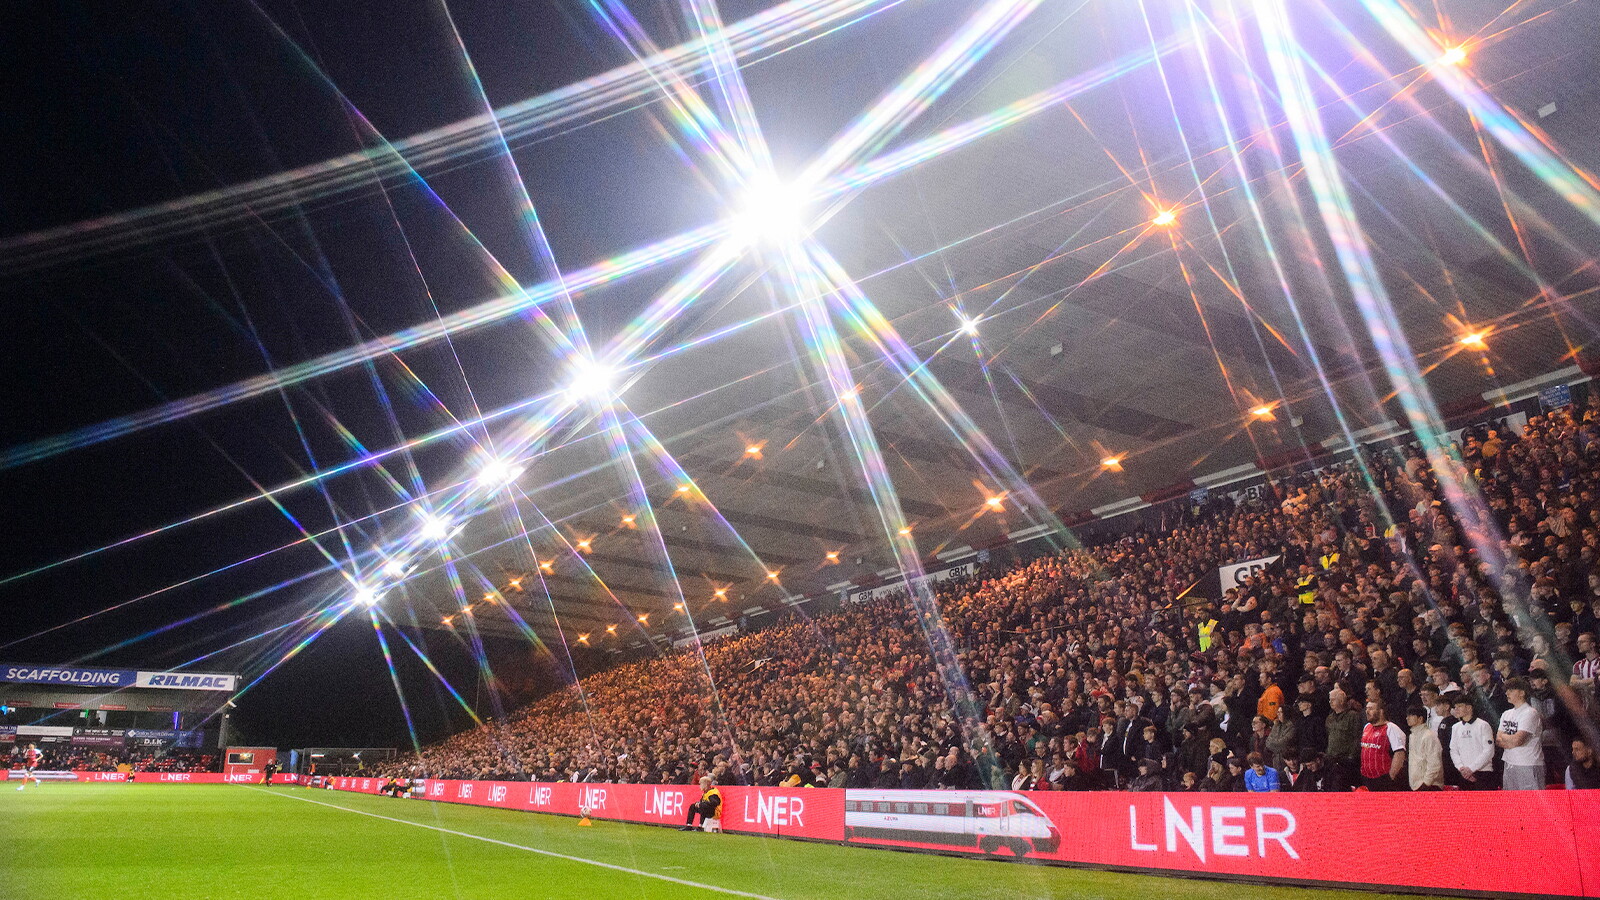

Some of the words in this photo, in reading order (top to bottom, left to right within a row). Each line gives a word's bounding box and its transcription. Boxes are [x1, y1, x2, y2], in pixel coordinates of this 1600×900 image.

[949, 565, 968, 578] GBM
[858, 590, 873, 601] GBM
[6, 668, 120, 684] SCAFFOLDING
[149, 674, 228, 688] RILMAC
[95, 773, 125, 781] LNER
[160, 773, 190, 781] LNER
[224, 774, 253, 782] LNER
[430, 781, 444, 797] LNER
[458, 782, 473, 799] LNER
[488, 783, 507, 804] LNER
[529, 784, 552, 808] LNER
[578, 785, 607, 810] LNER
[644, 786, 684, 818] LNER
[744, 789, 804, 830] LNER
[978, 806, 996, 815] LNER
[1129, 796, 1300, 864] LNER
